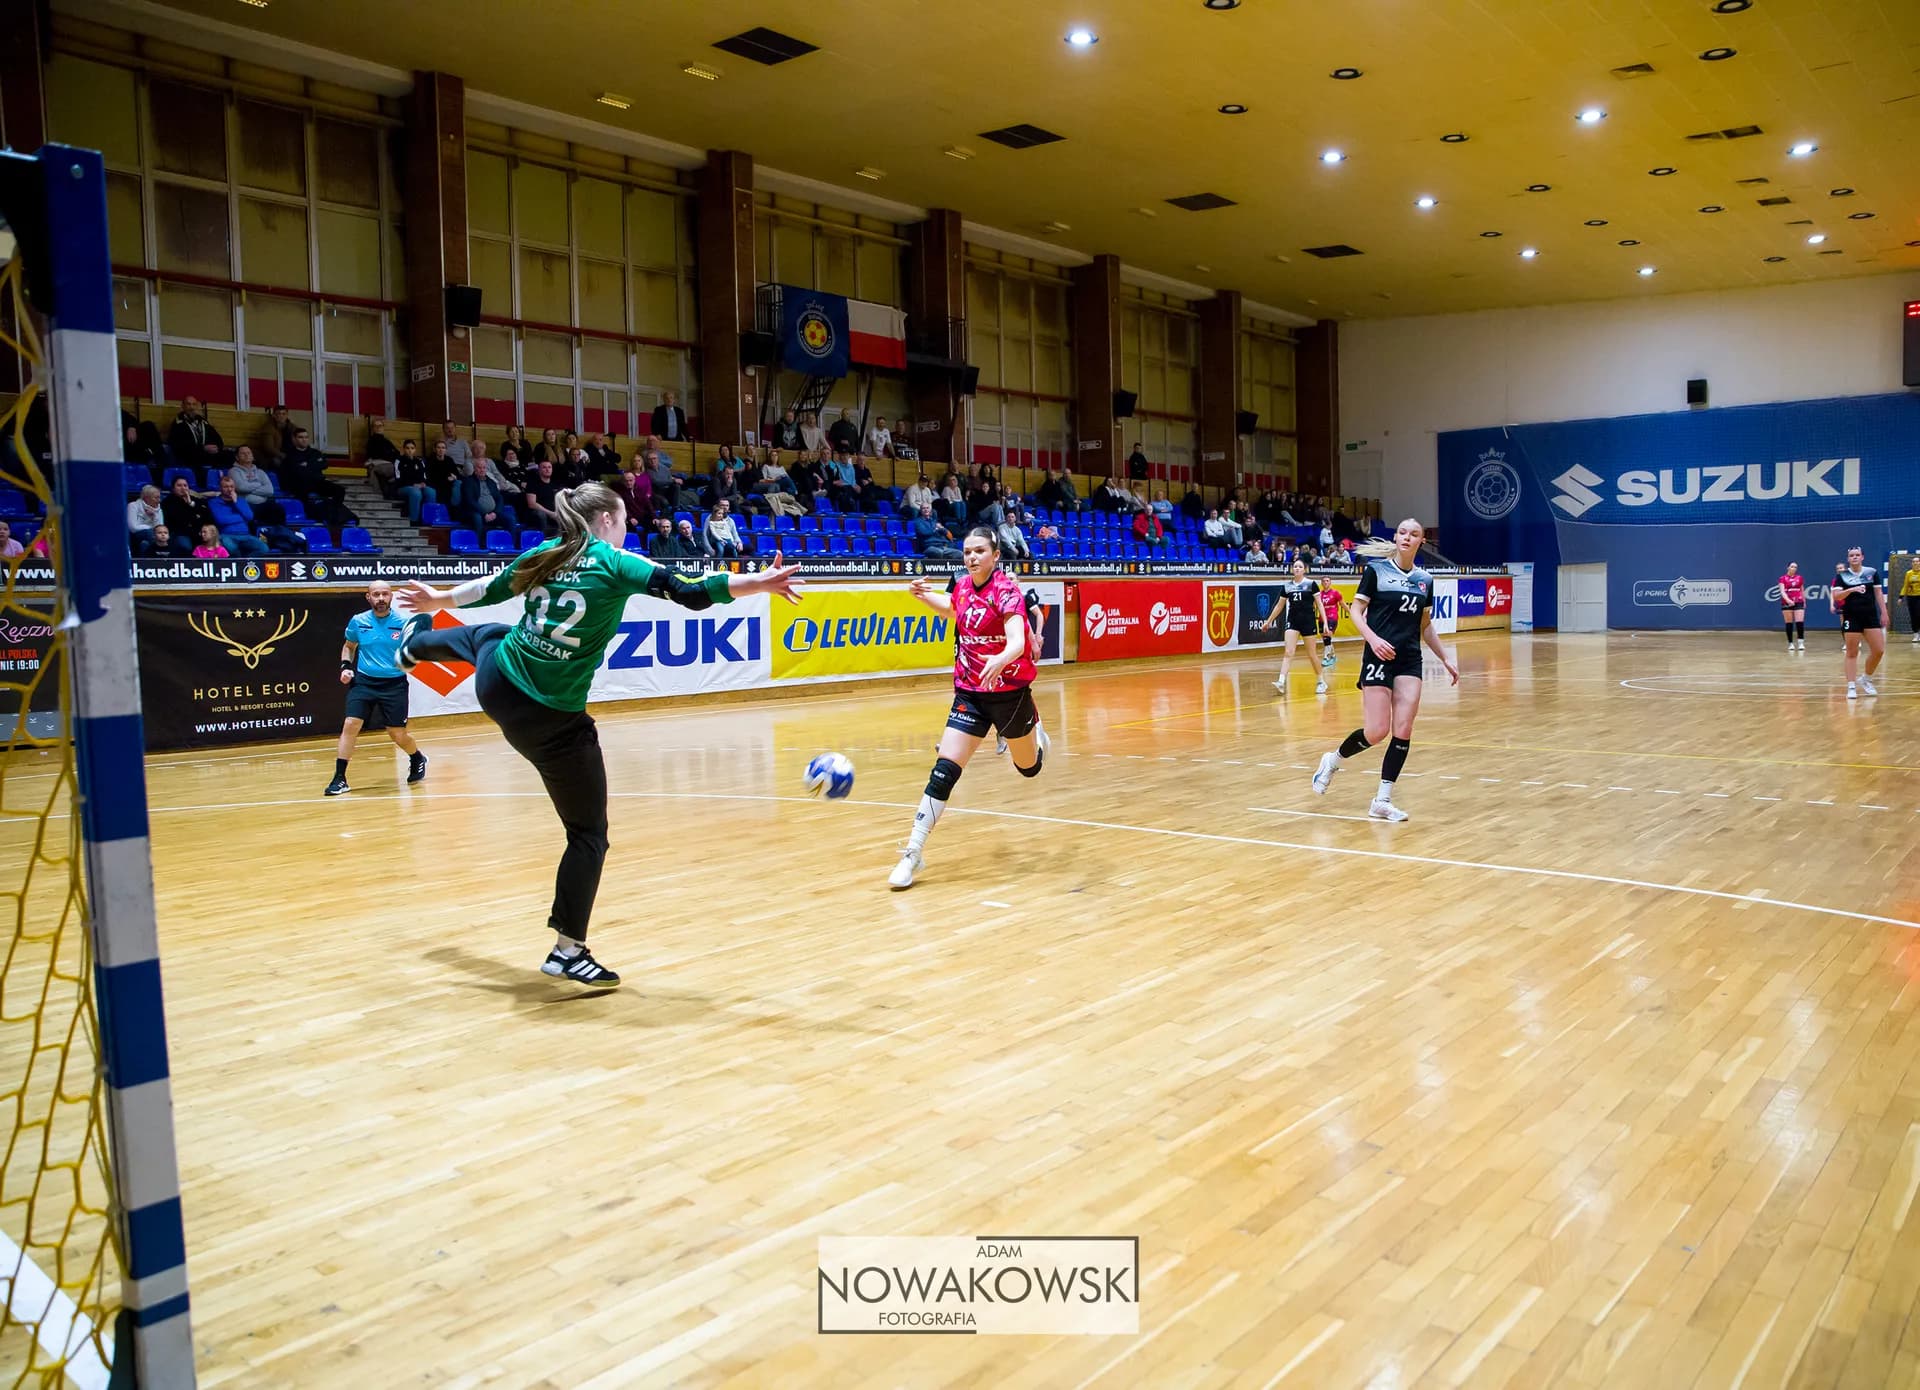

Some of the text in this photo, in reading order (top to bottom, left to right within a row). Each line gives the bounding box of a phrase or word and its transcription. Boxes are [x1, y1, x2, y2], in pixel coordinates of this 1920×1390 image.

[1616, 458, 1860, 506] SUZUKI
[1050, 563, 1122, 575] www.koronahandball.pl
[1293, 592, 1302, 601] 21
[1398, 594, 1418, 614] 24
[526, 586, 587, 648] 32
[964, 606, 987, 629] 17
[1170, 606, 1181, 614] LIGA
[1107, 617, 1140, 626] CENTRALNA
[1170, 615, 1198, 623] CENTRALNA
[1170, 623, 1187, 632] KOBIET
[1210, 610, 1229, 639] CK
[1844, 620, 1850, 630] 3
[0, 618, 56, 644] Ręczn
[819, 612, 949, 649] LEWIATAN
[1107, 626, 1127, 635] KOBIET
[520, 628, 573, 660] SOBCZAK
[596, 616, 761, 670] ZUKI
[8, 649, 38, 659] POLSKA
[17, 659, 40, 670] 19:00
[1365, 663, 1386, 681] 24
[193, 681, 310, 700] HOTEL ECHO
[265, 701, 295, 709] CEDZYNA
[195, 716, 313, 733] WWW.HOTELECHO.EU
